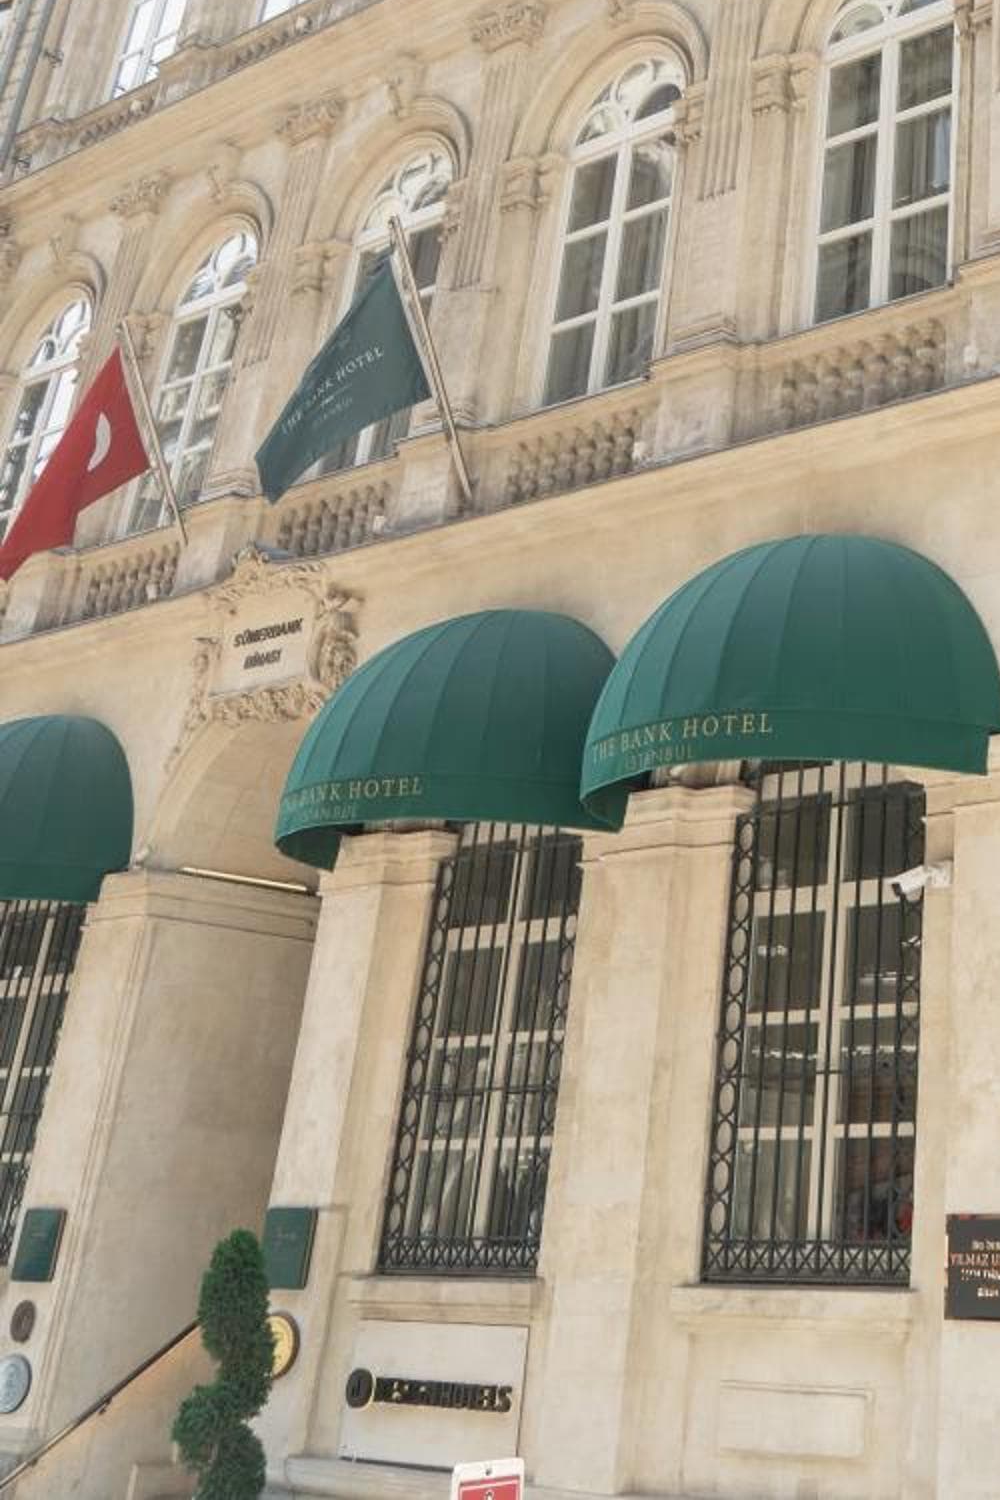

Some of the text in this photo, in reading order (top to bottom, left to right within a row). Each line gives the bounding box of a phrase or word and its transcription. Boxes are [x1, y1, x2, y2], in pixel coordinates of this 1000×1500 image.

[336, 347, 385, 382] HOTEL
[620, 722, 673, 753] BANK
[683, 712, 773, 740] HOTEL
[349, 775, 423, 800] HOTEL
